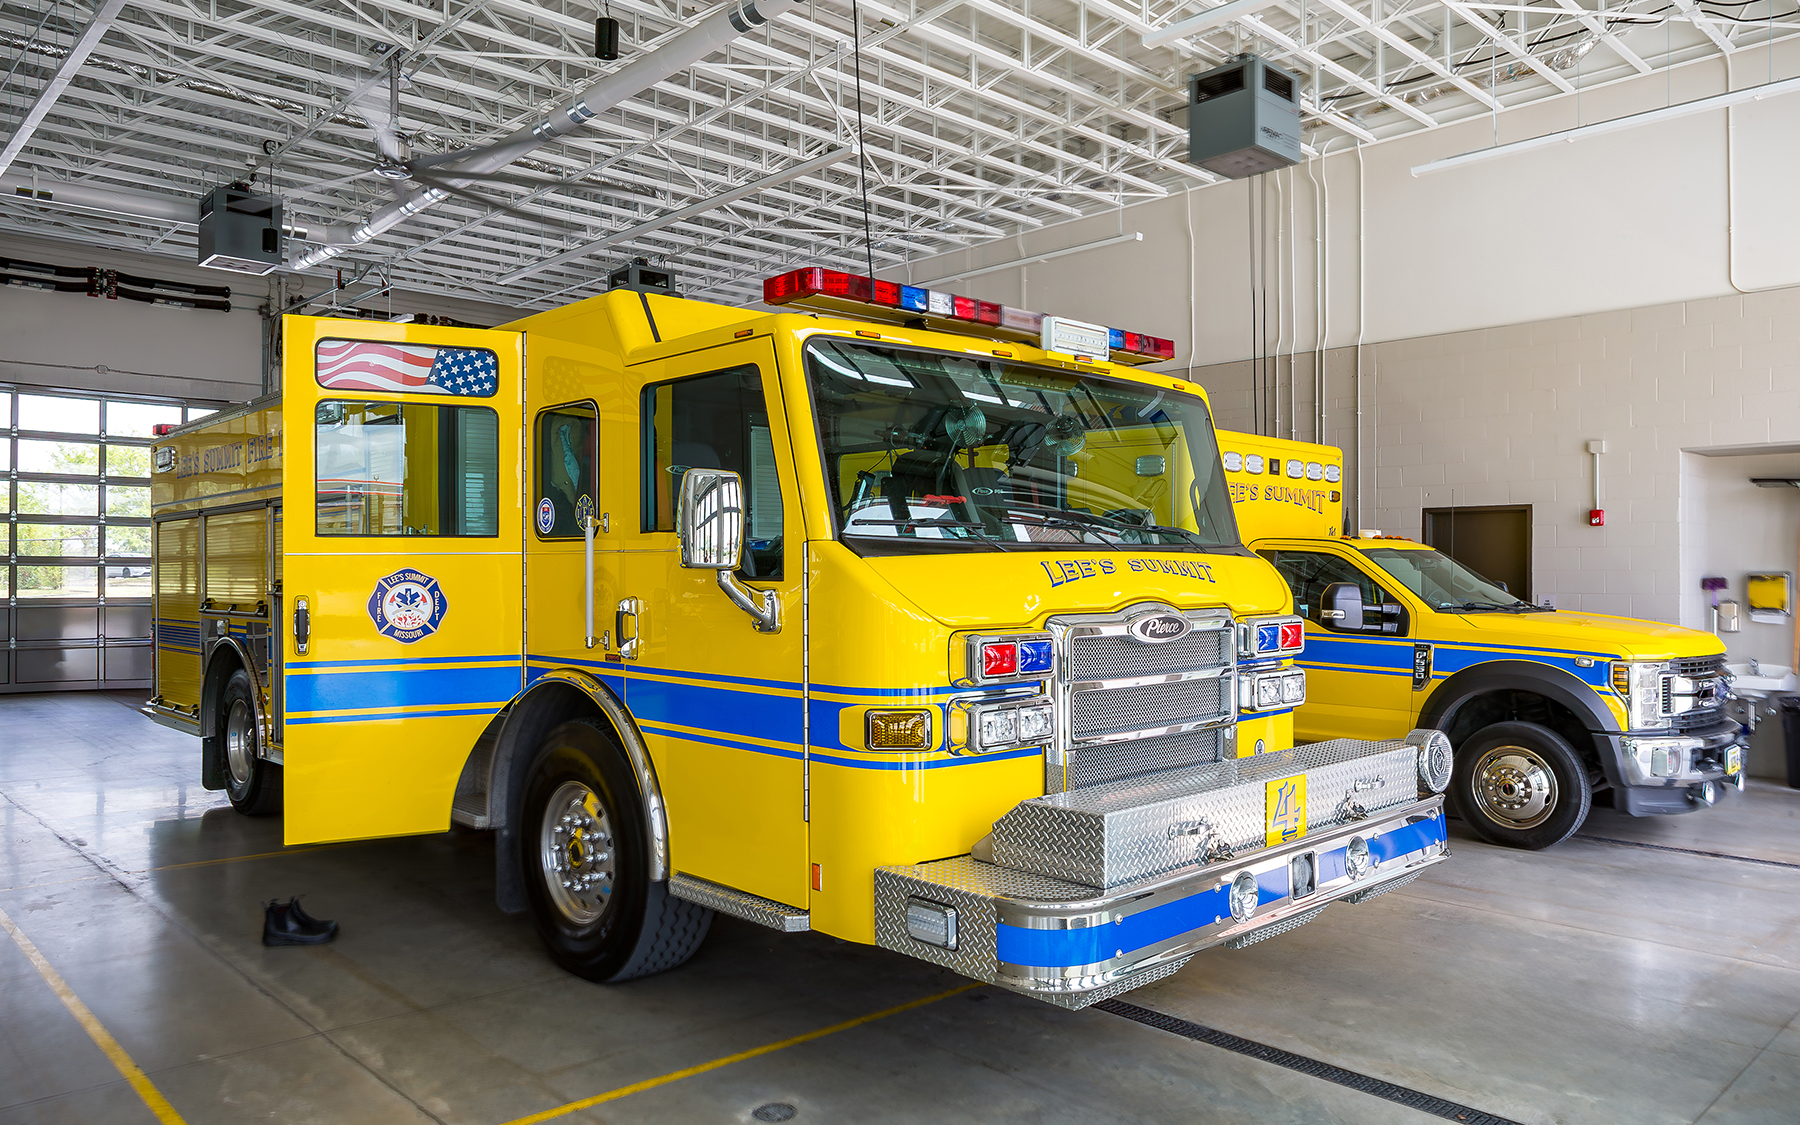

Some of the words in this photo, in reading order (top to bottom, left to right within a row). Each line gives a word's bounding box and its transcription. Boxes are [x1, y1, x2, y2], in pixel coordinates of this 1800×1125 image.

[203, 441, 242, 473] SUMMIT
[247, 433, 274, 464] FIRE
[1264, 485, 1326, 514] SUMMIT
[387, 573, 404, 585] LEE'S
[404, 572, 429, 585] SUMMIT
[1040, 558, 1117, 588] LEE'S
[1127, 558, 1216, 584] SUMMIT
[393, 628, 424, 639] MISSOURI
[1147, 617, 1180, 637] Pierce
[1272, 781, 1301, 836] 4
